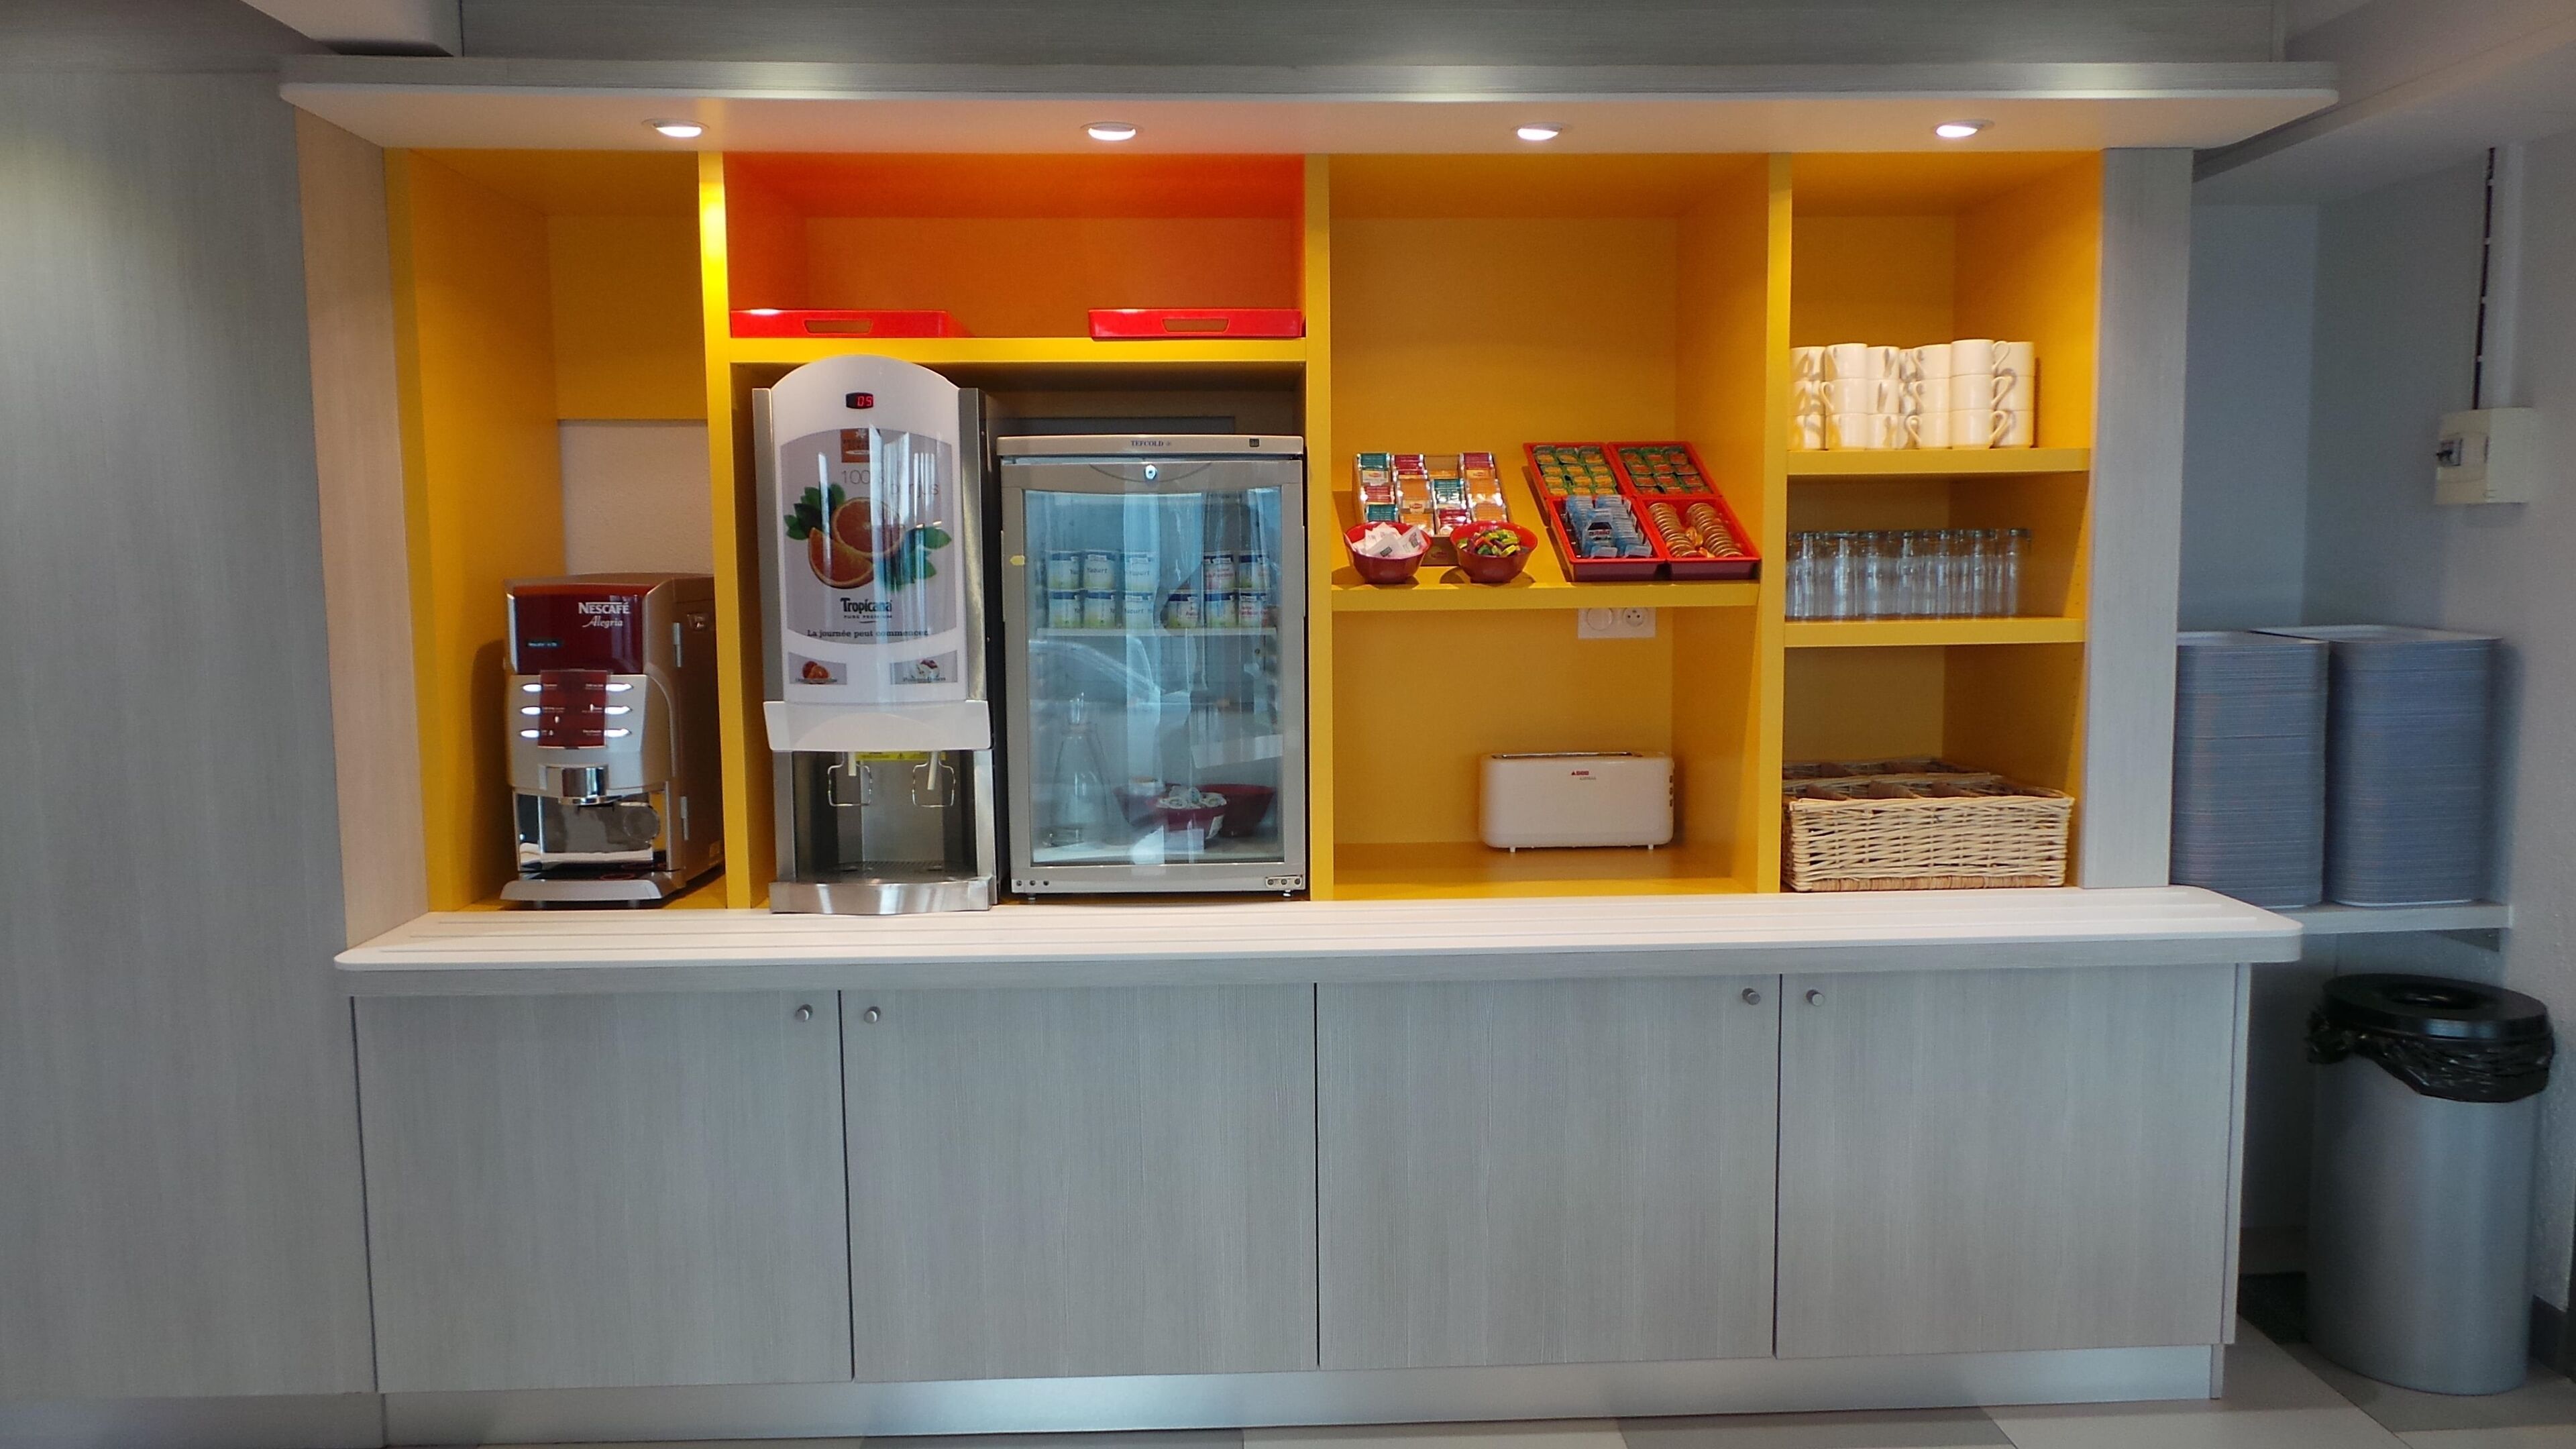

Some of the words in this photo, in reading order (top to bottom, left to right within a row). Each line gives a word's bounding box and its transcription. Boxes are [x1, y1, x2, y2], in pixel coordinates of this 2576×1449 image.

[578, 602, 631, 614] NESCAFÉ
[840, 597, 892, 614] Tropicana
[582, 615, 623, 629] Alegria
[819, 630, 851, 638] journée
